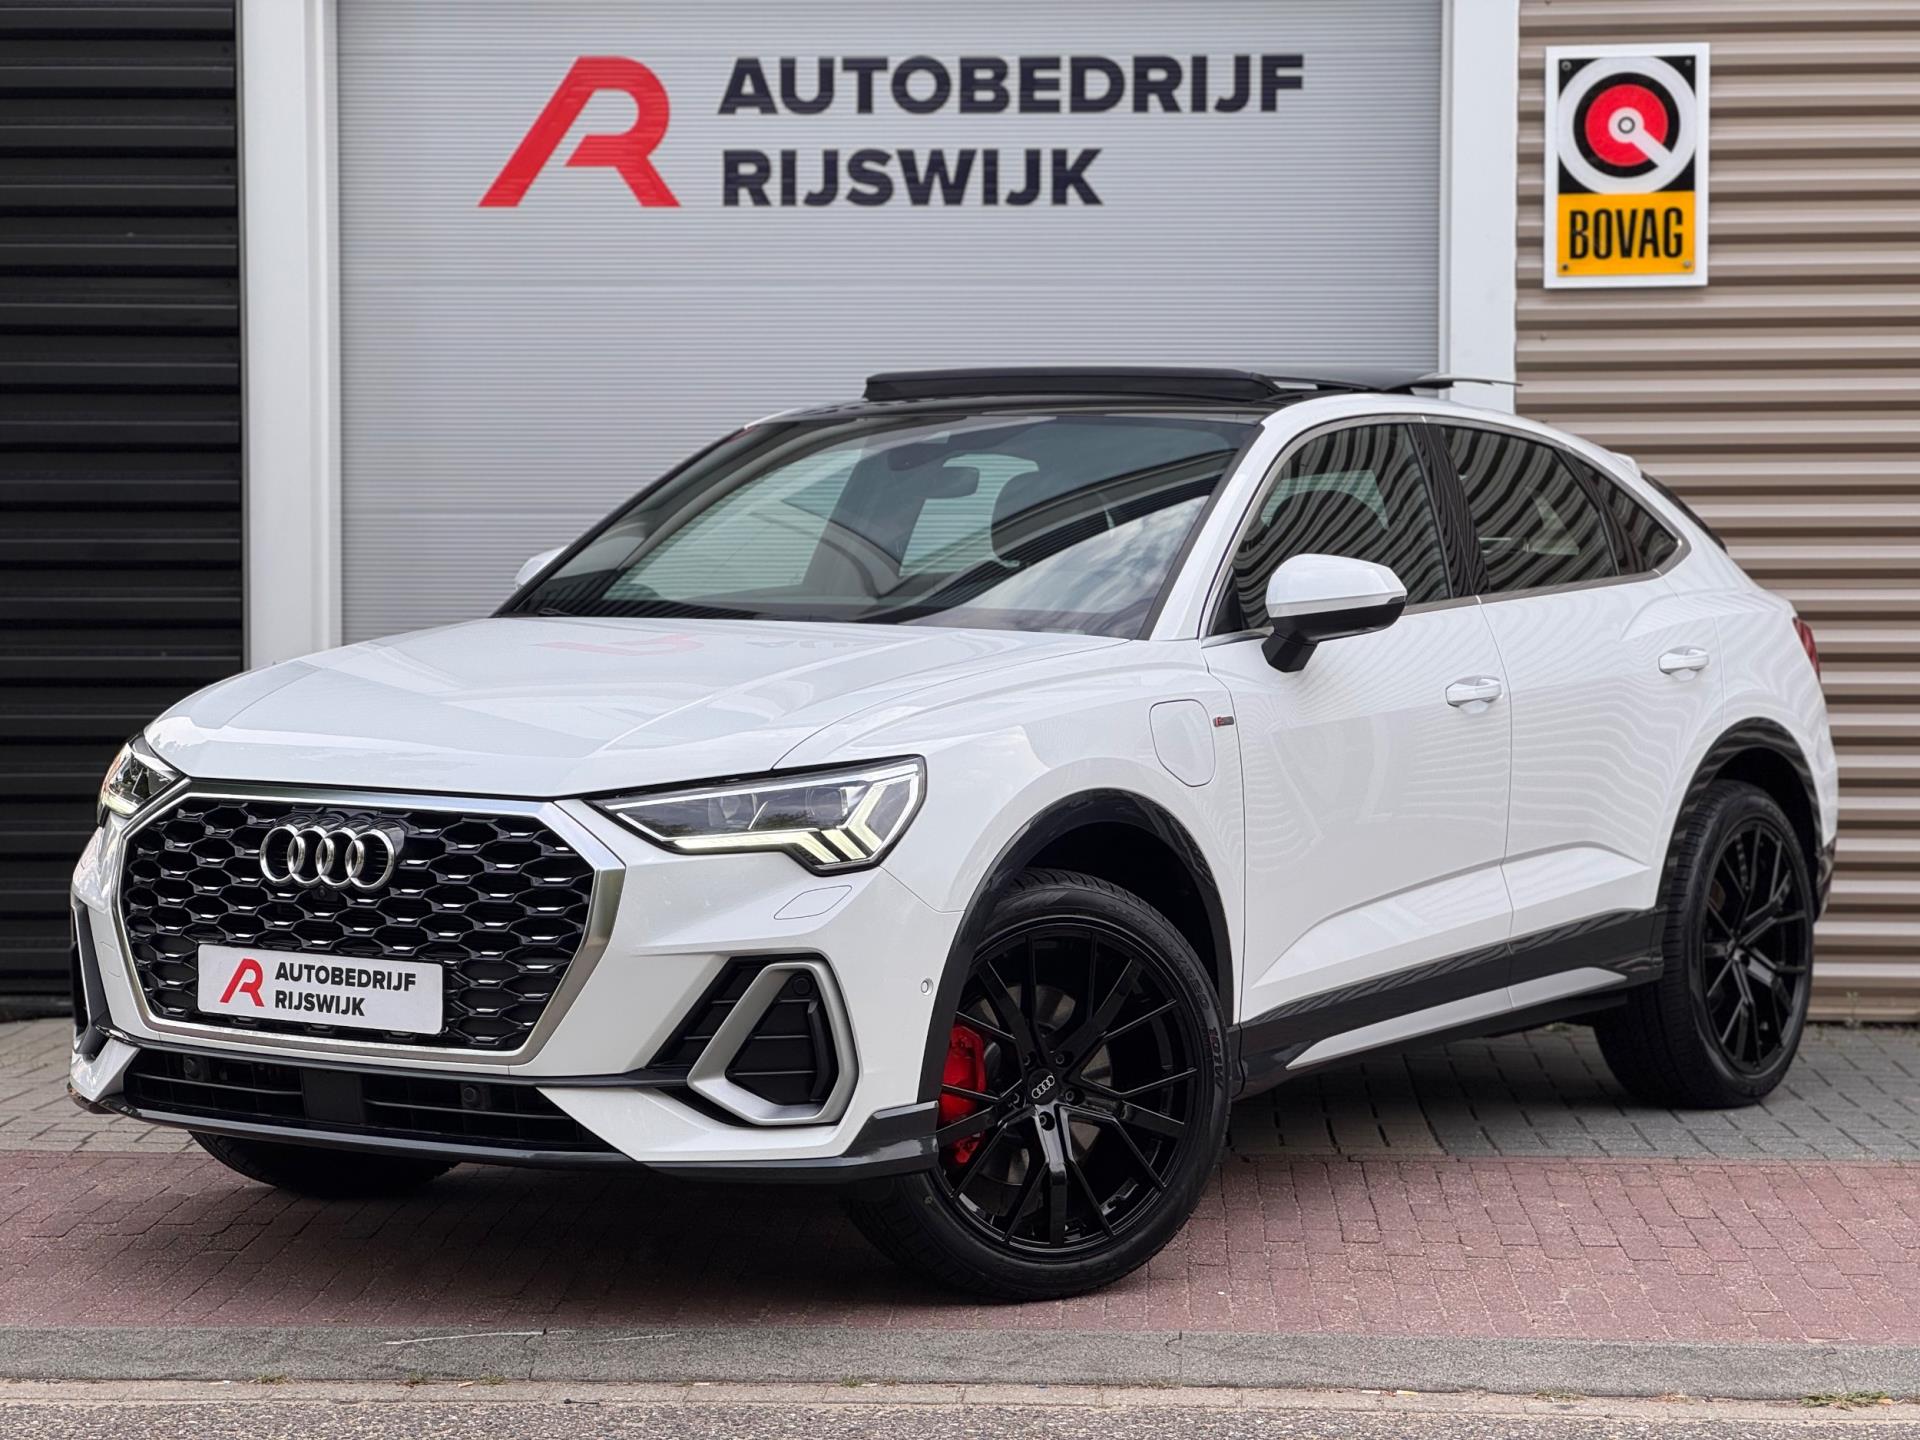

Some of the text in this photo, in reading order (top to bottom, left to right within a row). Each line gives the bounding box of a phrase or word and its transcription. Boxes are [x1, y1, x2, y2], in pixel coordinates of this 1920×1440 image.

[719, 54, 1304, 115] AUTOBEDRIJF
[724, 149, 1104, 208] RIJSWIJK
[1569, 207, 1684, 260] BOVAG
[275, 961, 417, 993] AUTOBEDRIJF
[275, 990, 366, 1017] RIJSWIJK
